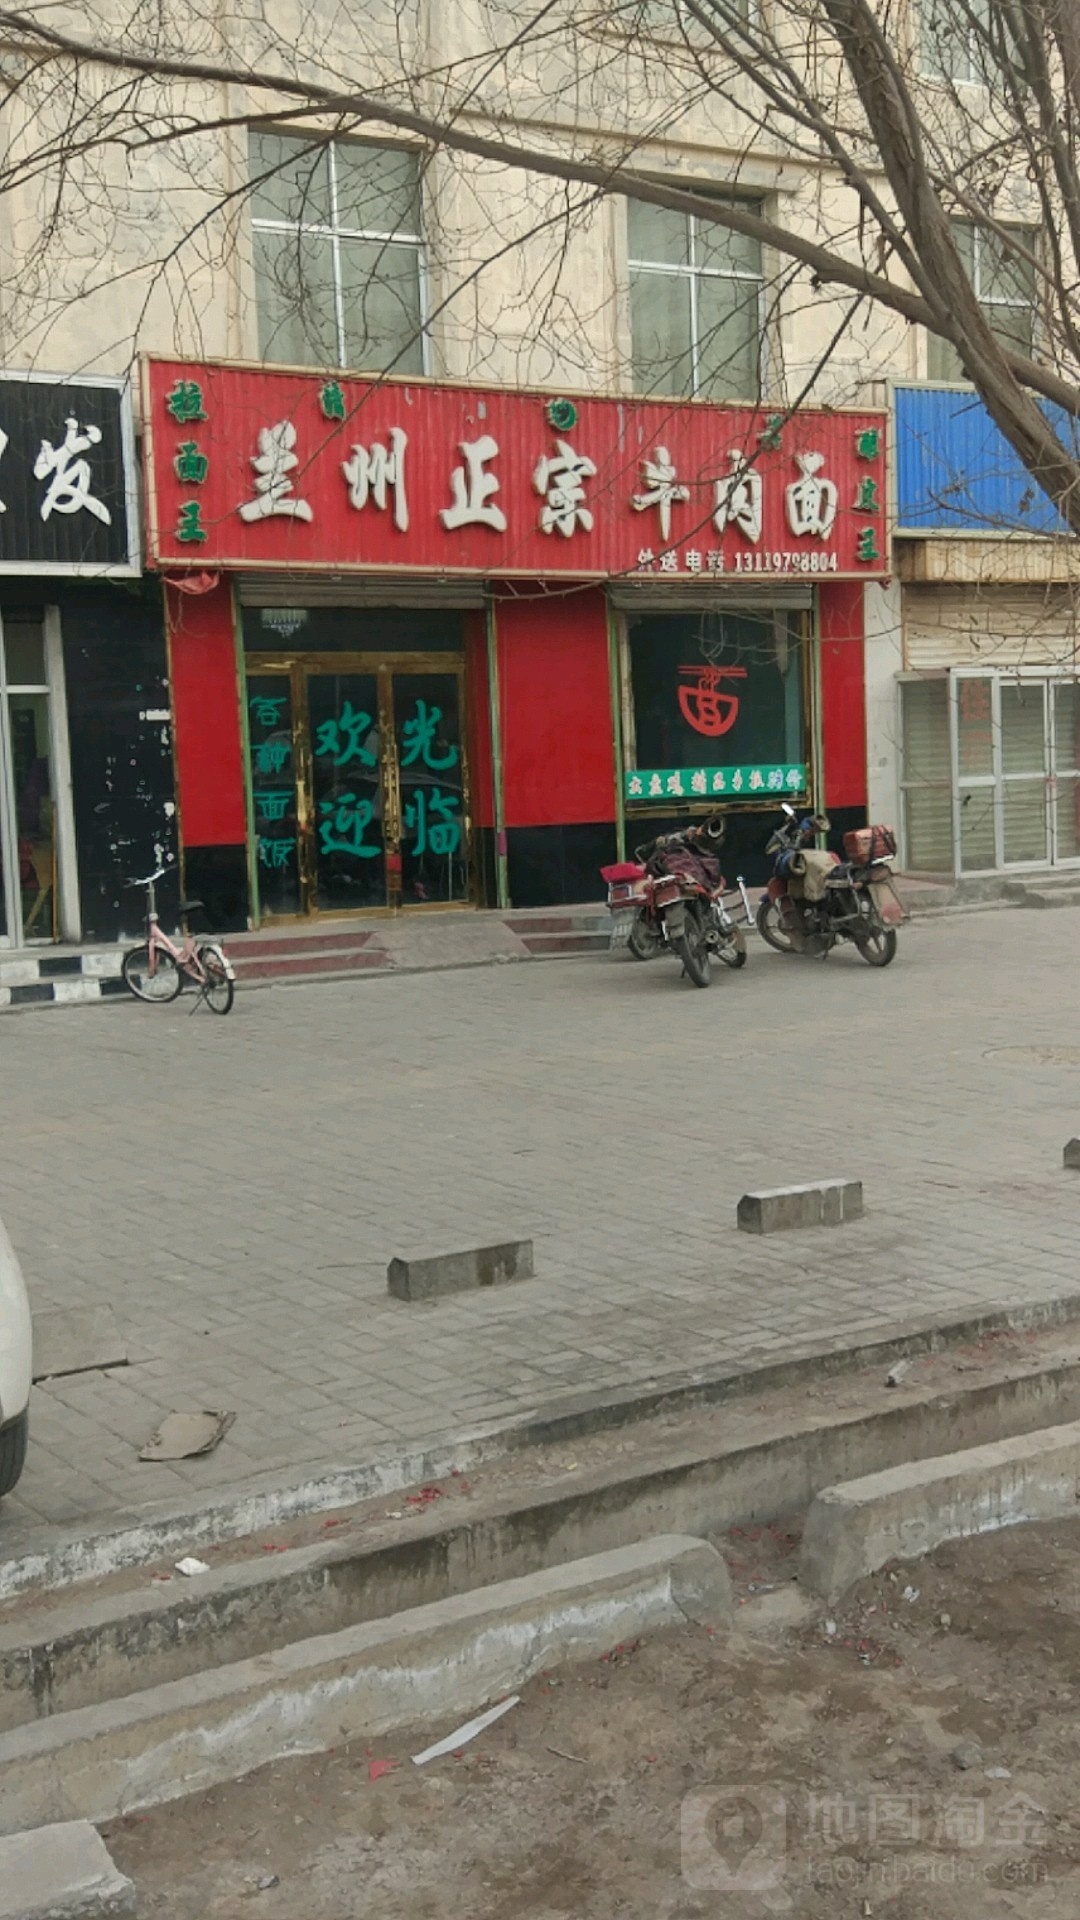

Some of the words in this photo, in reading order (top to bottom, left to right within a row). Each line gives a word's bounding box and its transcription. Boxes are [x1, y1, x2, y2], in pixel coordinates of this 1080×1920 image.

[0, 418, 112, 525] 发
[168, 379, 207, 543] 拉面王
[238, 420, 837, 544] 兰州正宗牛肉面
